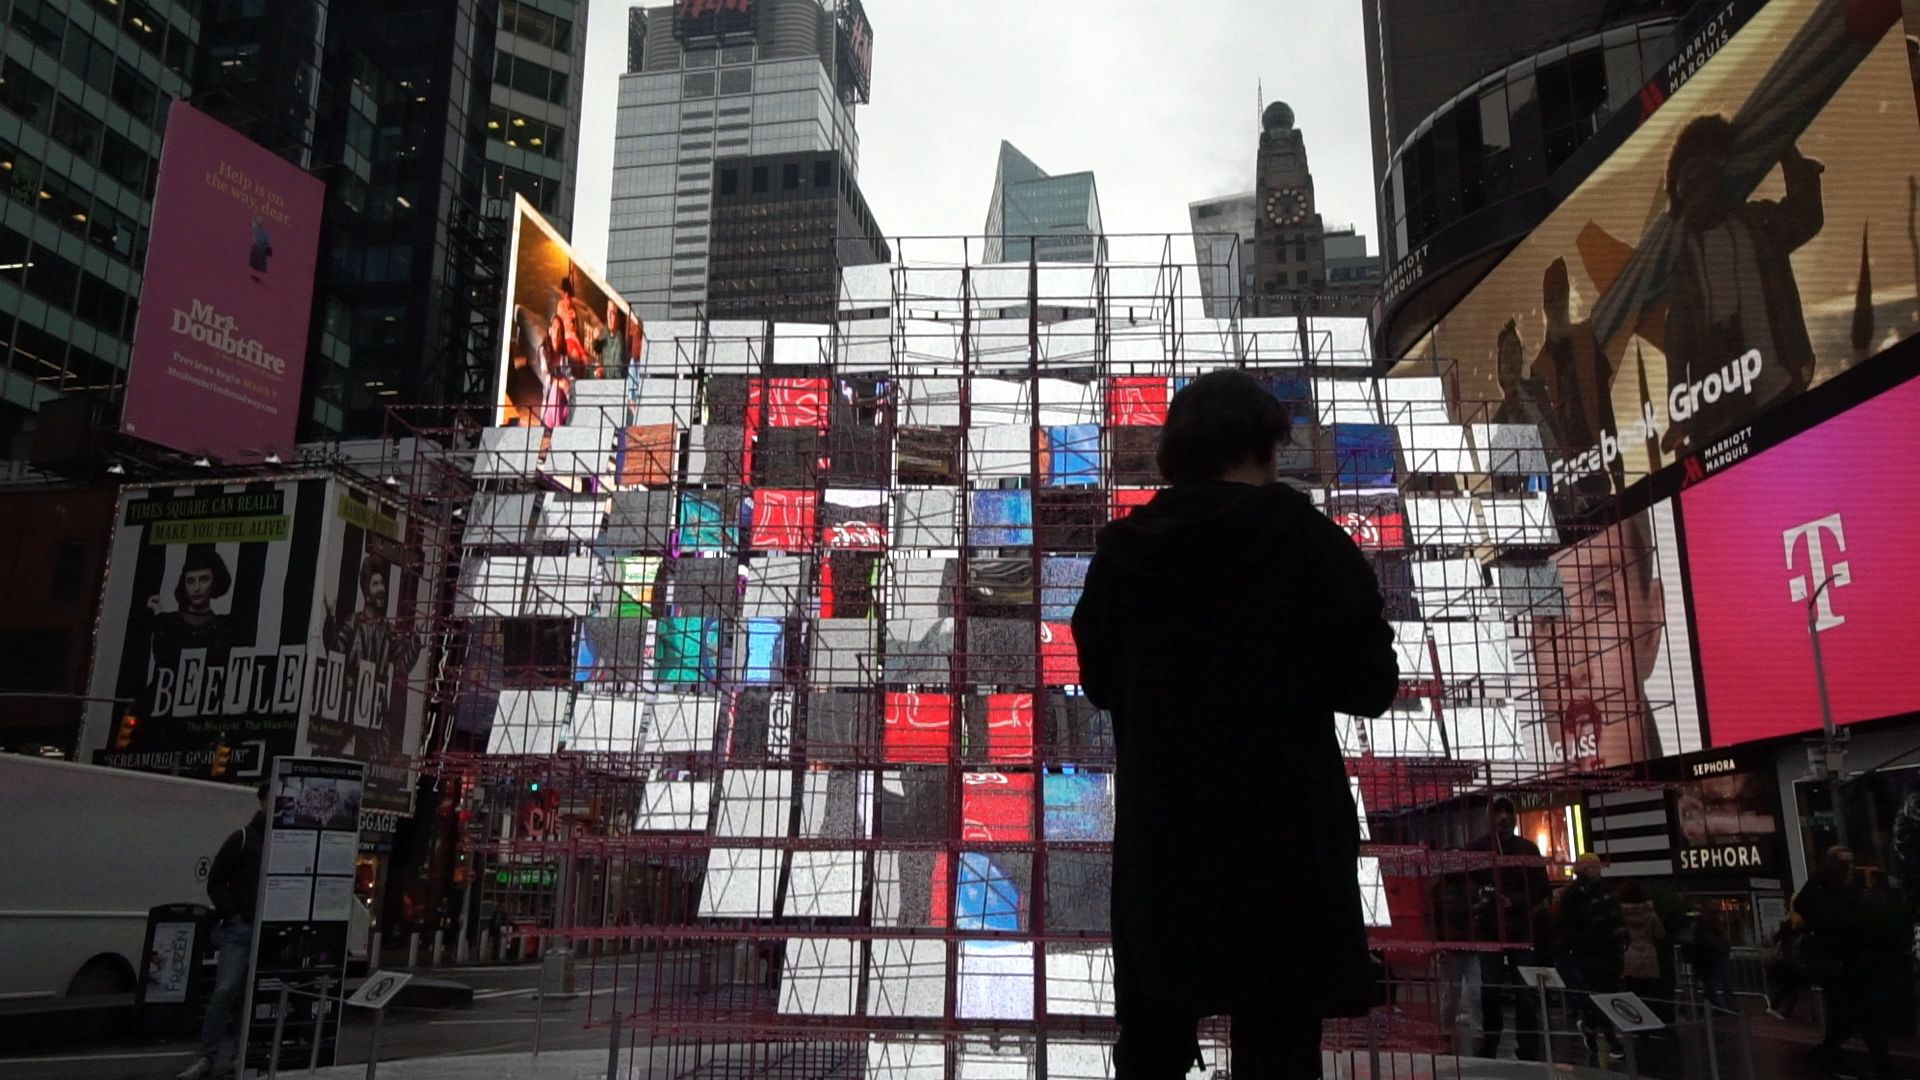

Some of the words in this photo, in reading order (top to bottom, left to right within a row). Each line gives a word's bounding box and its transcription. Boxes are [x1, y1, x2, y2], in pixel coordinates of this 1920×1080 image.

[1668, 2, 1735, 77] MARRIOTT
[1670, 29, 1728, 93] MARQUIS
[205, 172, 228, 193] the
[218, 160, 252, 190] Help
[255, 183, 266, 196] is
[267, 190, 284, 207] on
[1383, 244, 1429, 292] MARRIOTT
[1384, 265, 1423, 305] MARQUIS
[189, 298, 239, 331] Mrs.
[170, 308, 286, 375] Doubtfire
[1669, 348, 1762, 423] Group
[1704, 426, 1752, 459] MARRIOTT
[1706, 443, 1748, 472] MARQUIS
[129, 502, 164, 520] TIMES
[166, 496, 207, 519] SQUARE
[211, 497, 233, 513] CAN
[237, 491, 280, 512] REALLY
[153, 522, 188, 541] MAKE
[192, 521, 215, 539] YOU
[218, 520, 246, 537] FEEL
[1553, 733, 1597, 763] GASS
[1692, 758, 1736, 777] SEPHORA
[1680, 845, 1762, 869] SEPHORA
